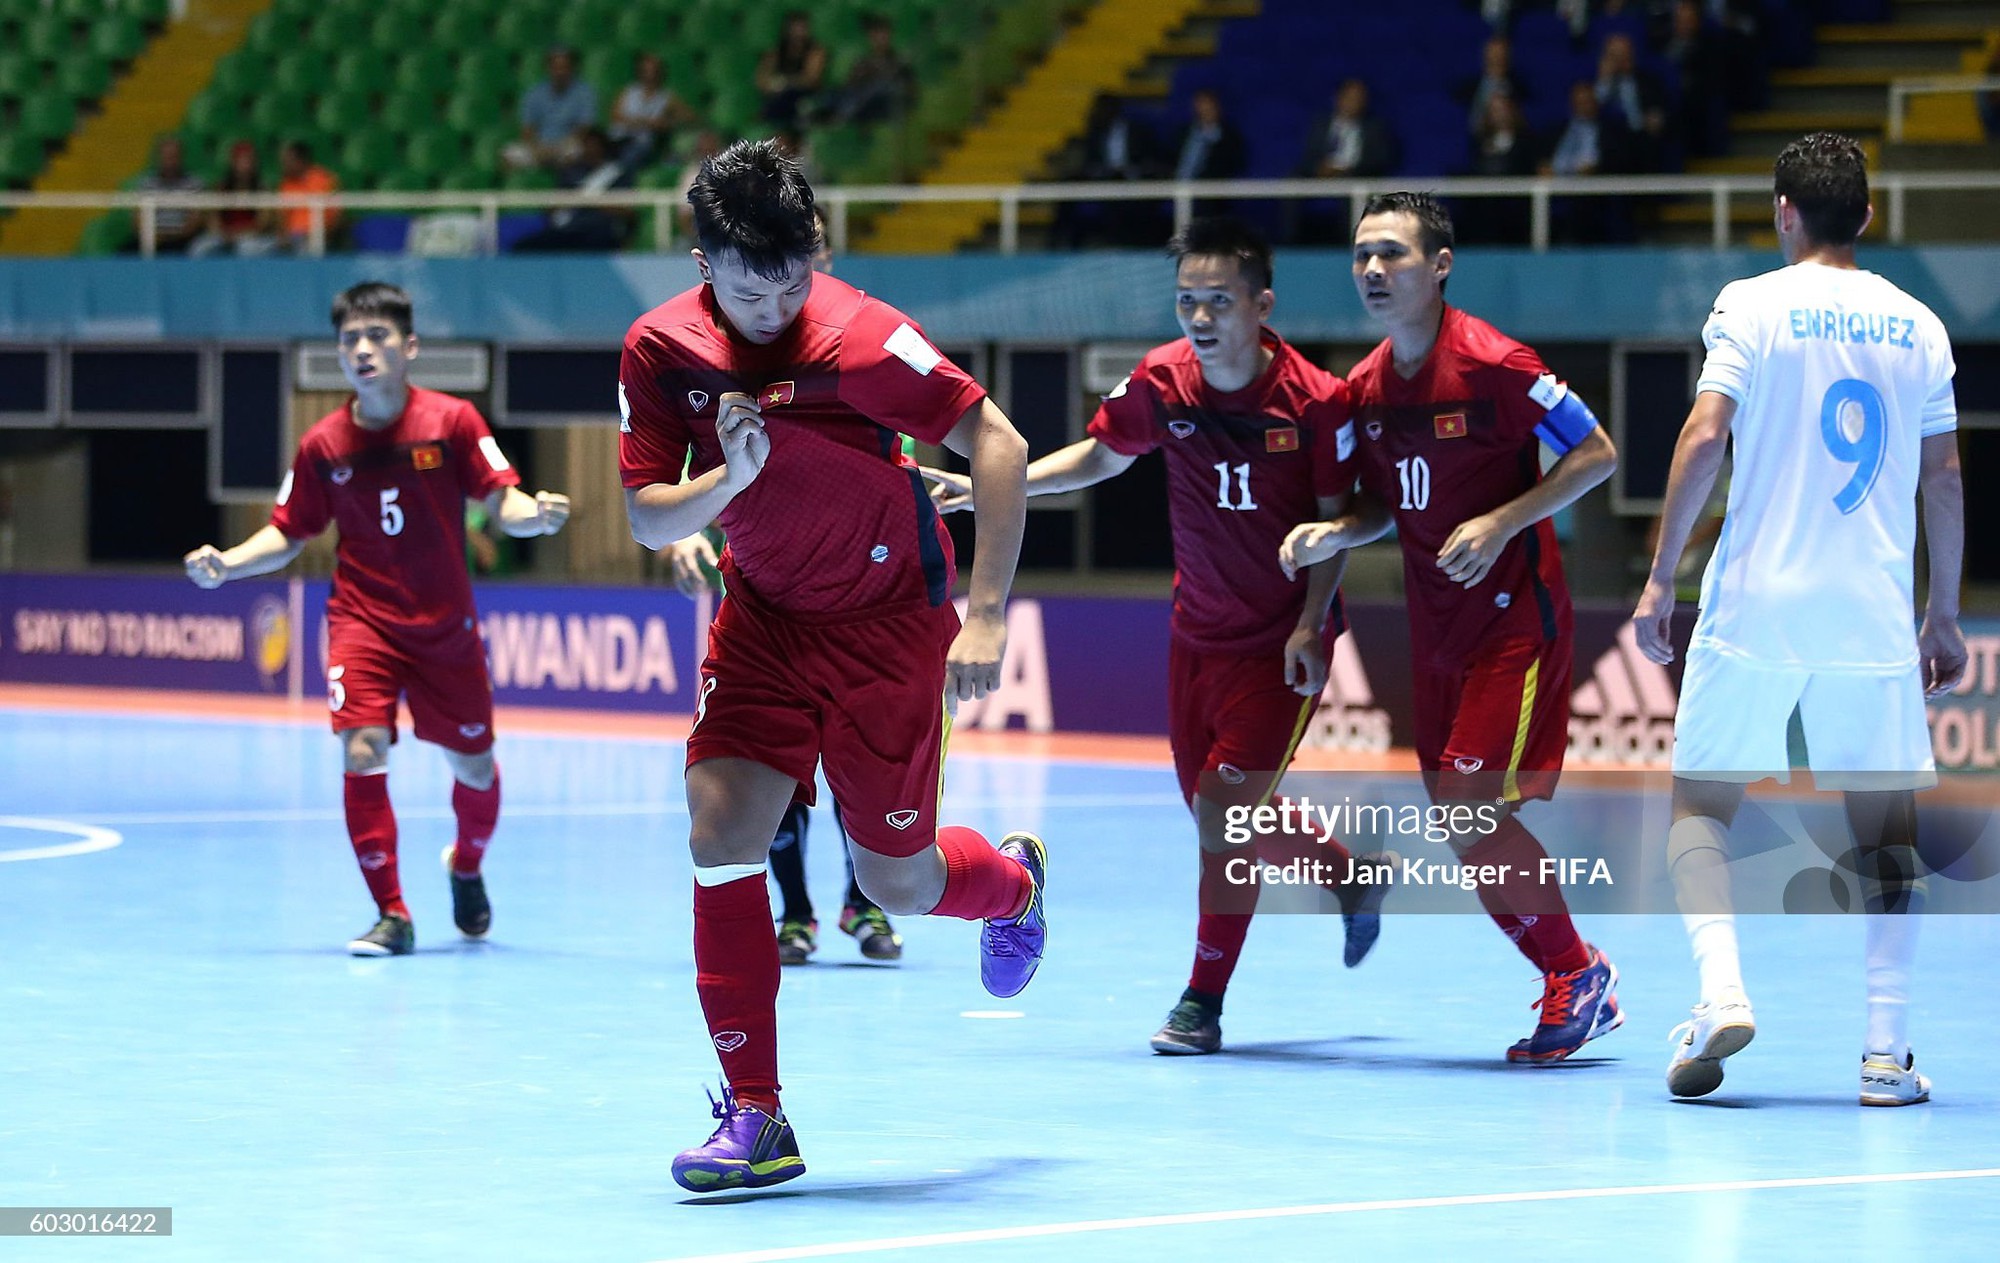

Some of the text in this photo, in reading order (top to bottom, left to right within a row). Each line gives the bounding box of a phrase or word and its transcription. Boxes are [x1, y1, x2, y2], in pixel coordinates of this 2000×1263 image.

[1820, 378, 1887, 516] 9
[1213, 460, 1258, 511] 11
[1395, 455, 1430, 511] 10
[379, 487, 404, 536] 5
[15, 608, 245, 663] SAY NO TO RACISM
[486, 611, 679, 695] WANDA
[327, 664, 346, 713] 5
